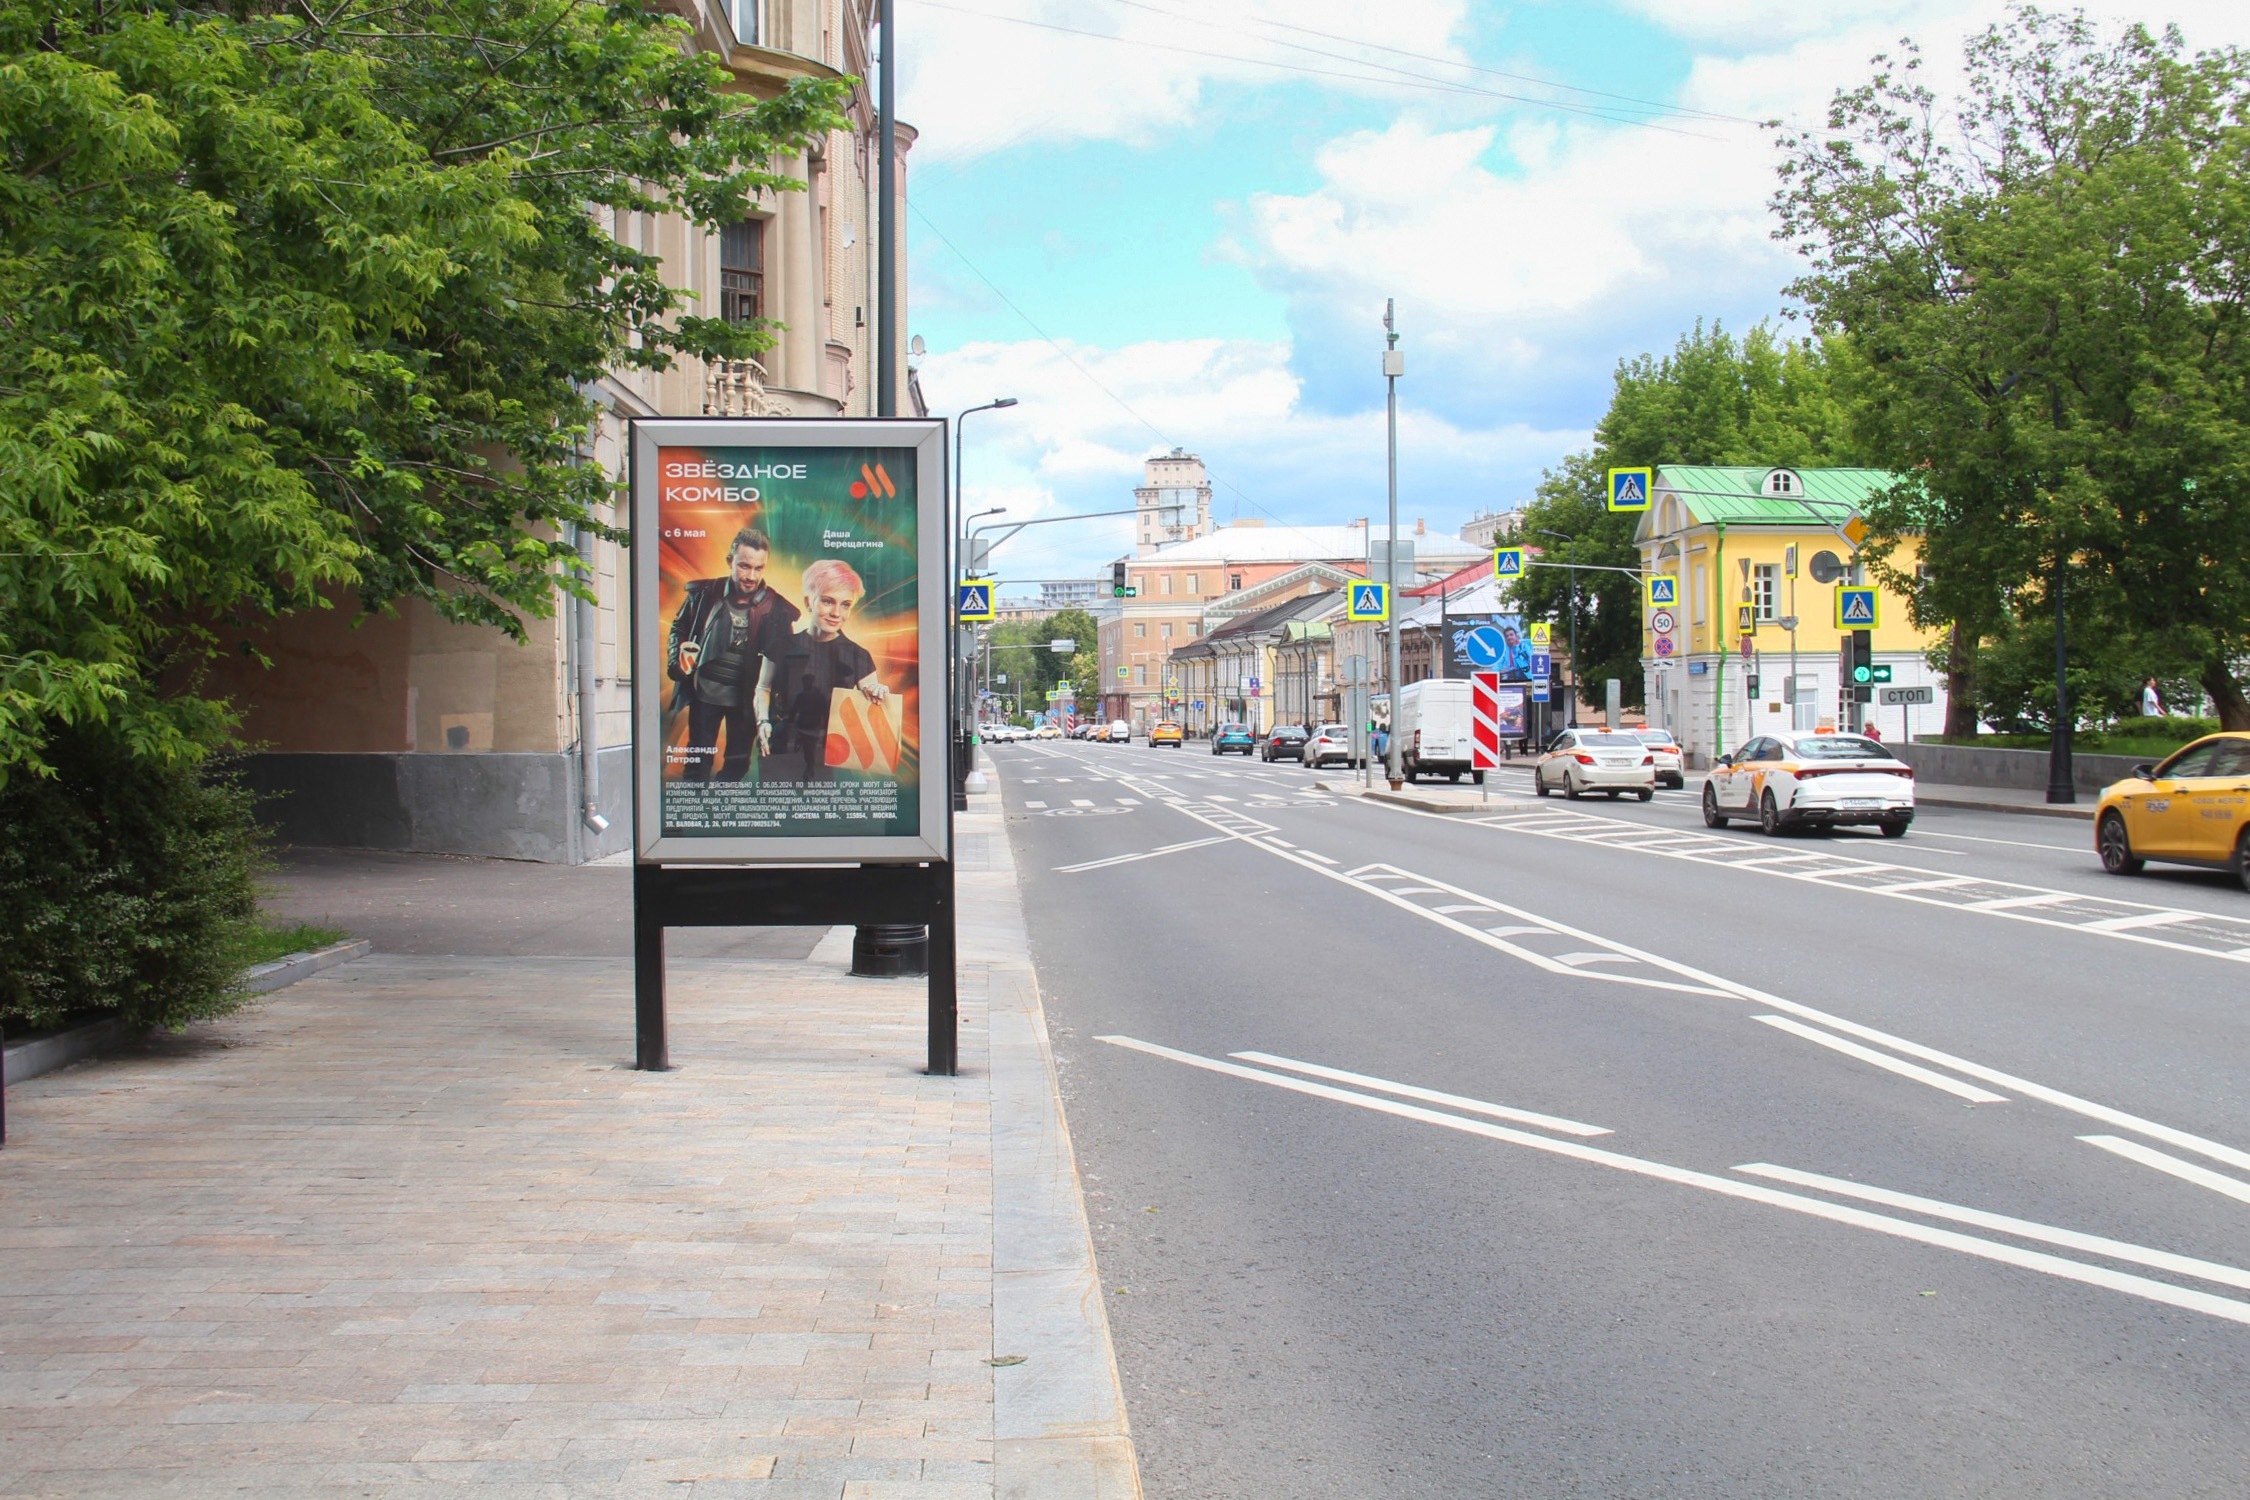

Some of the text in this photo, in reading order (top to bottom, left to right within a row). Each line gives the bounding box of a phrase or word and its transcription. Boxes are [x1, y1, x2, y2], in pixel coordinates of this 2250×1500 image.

[665, 460, 807, 479] ЗВЁЗДНОЕ
[665, 487, 760, 502] КОМБО
[664, 528, 706, 538] с 6 мая
[823, 530, 850, 540] Даша
[823, 539, 884, 549] Верещагина
[1657, 618, 1670, 628] 50
[1888, 690, 1925, 702] СТОП
[666, 745, 718, 755] Александр
[666, 755, 701, 764] Петров
